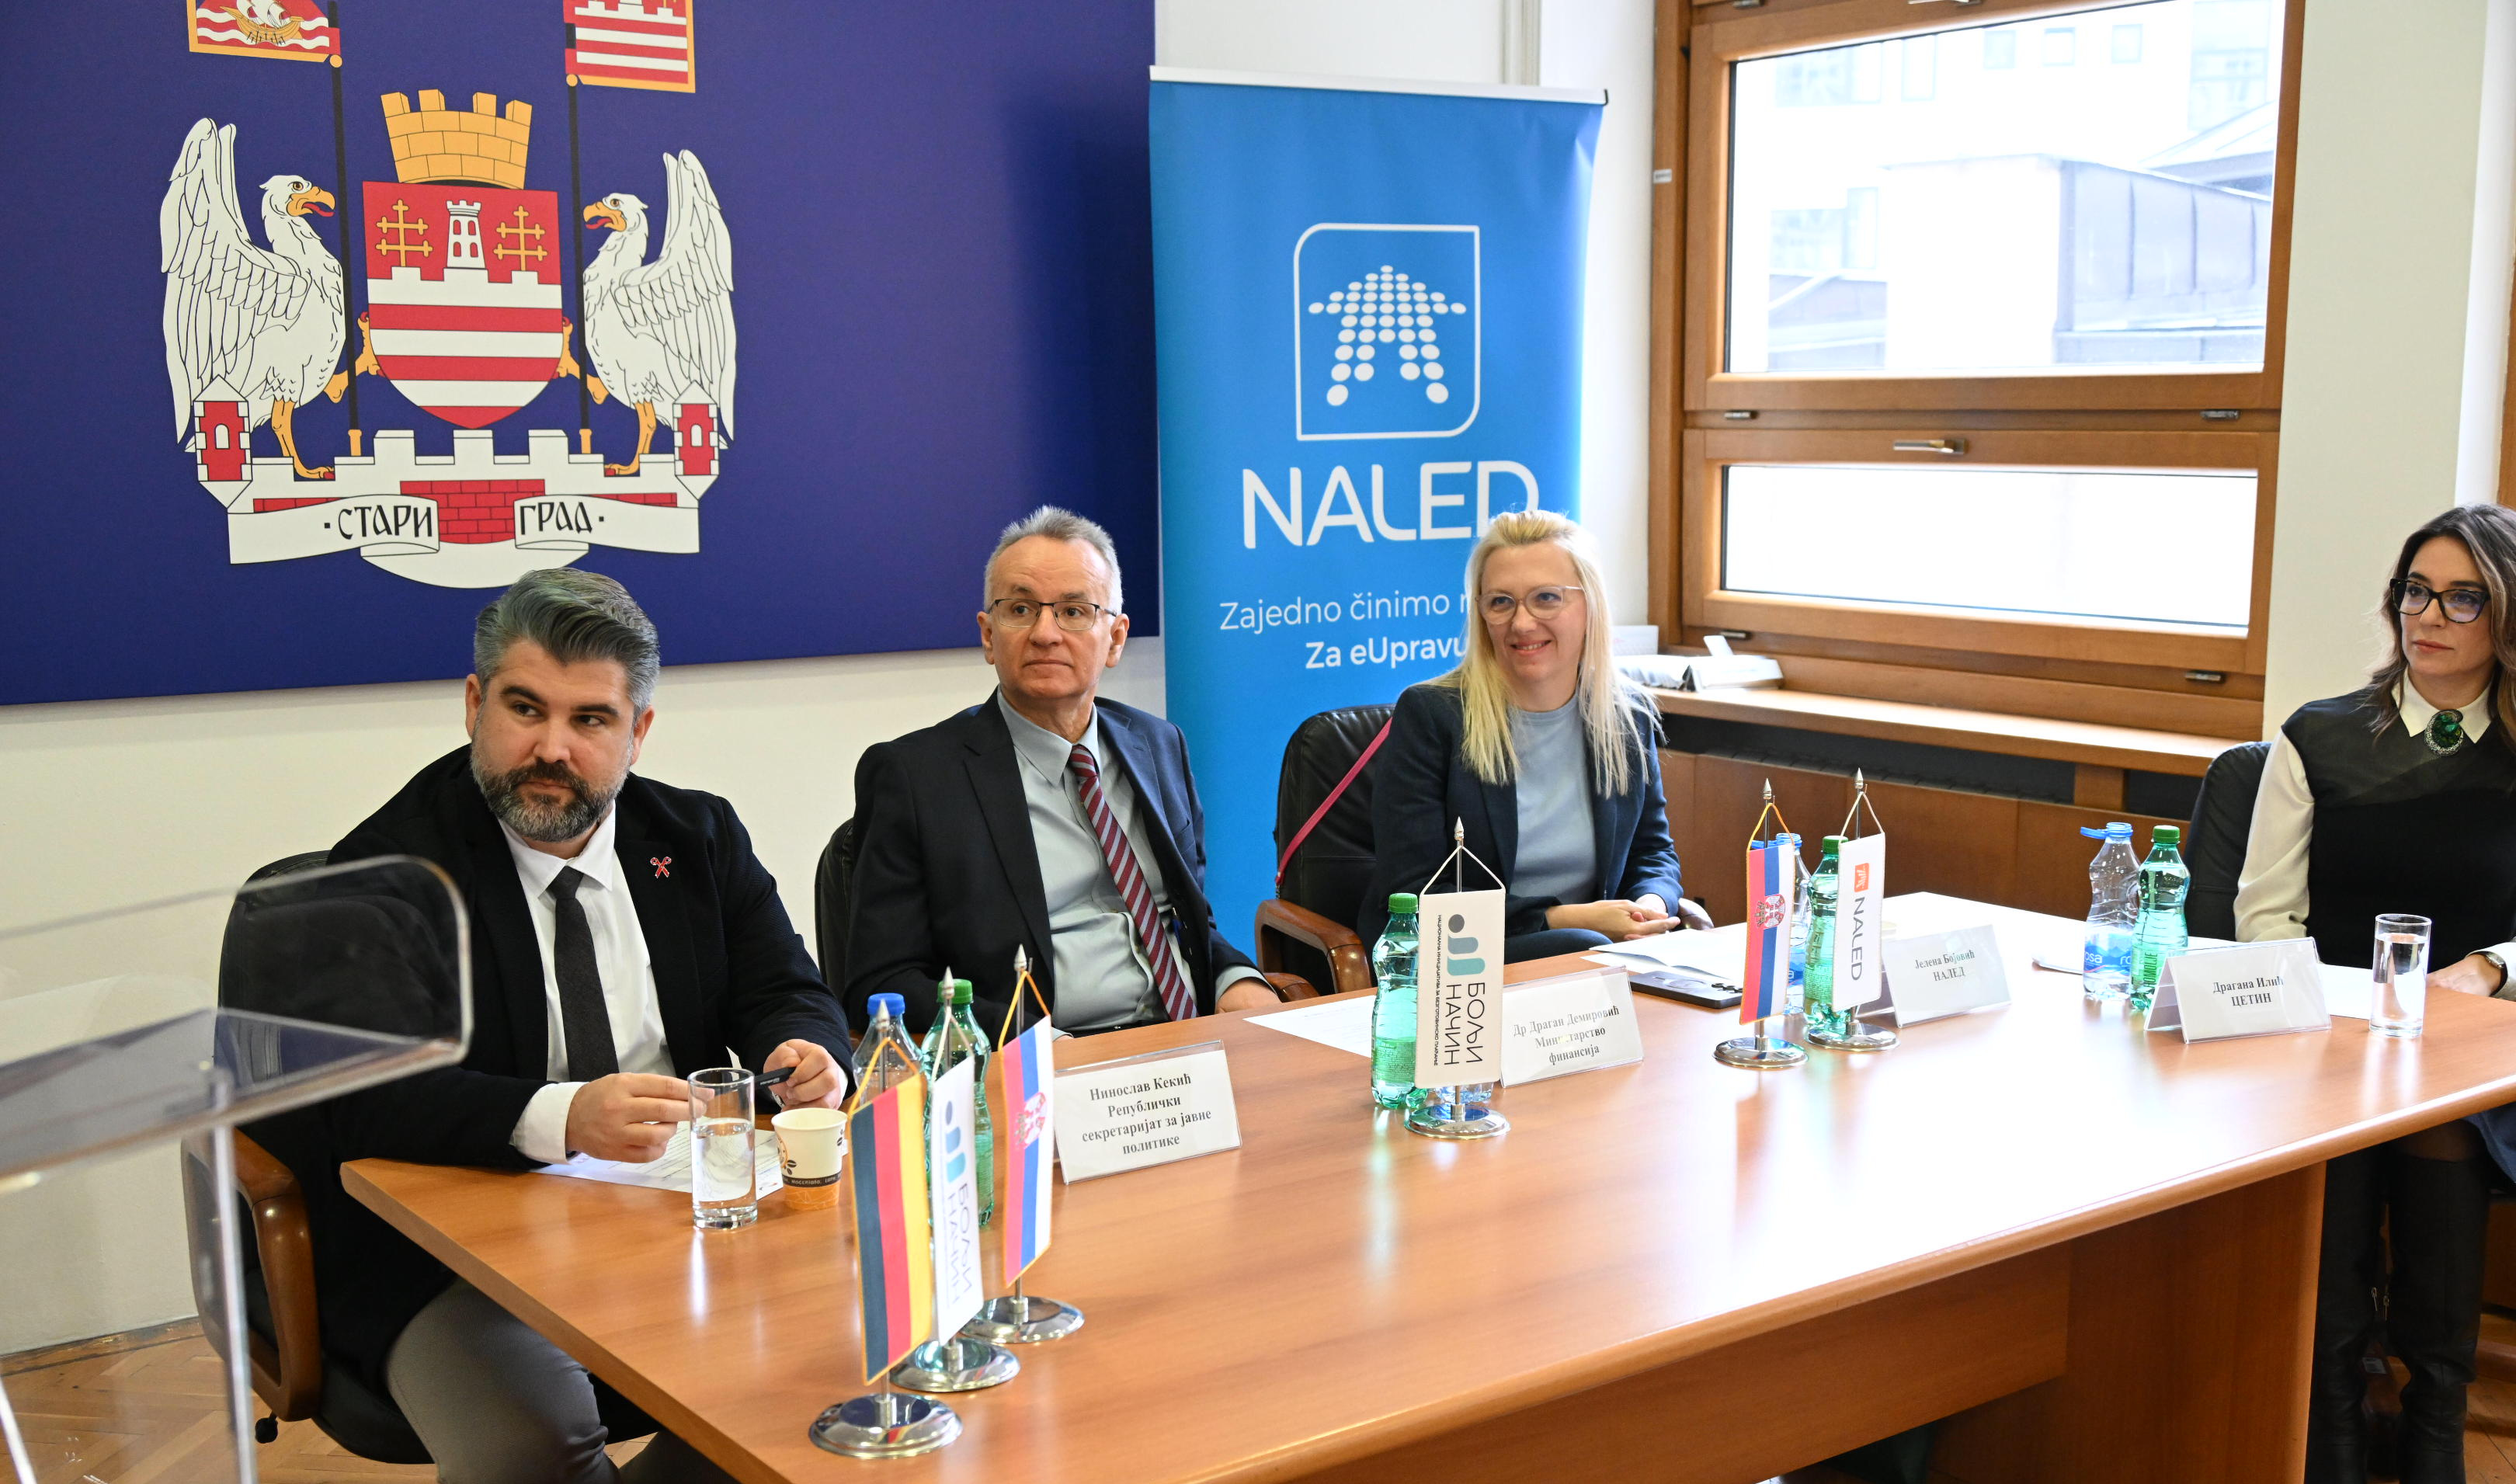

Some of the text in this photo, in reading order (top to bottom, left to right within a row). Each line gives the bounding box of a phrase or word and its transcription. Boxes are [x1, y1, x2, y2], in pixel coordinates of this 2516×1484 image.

[1242, 460, 1540, 549] NALED
[338, 502, 593, 540] СТАРИ ГРАД
[1219, 596, 1341, 634] Zajedno
[1350, 590, 1450, 620] činimo
[1305, 636, 1467, 669] Za eUpravu
[1851, 897, 1865, 981] NALED
[1915, 949, 1975, 969] Јелена Бојовић
[2085, 951, 2103, 964] osa
[1934, 967, 1965, 981] НАЛЕД
[2213, 975, 2284, 994] Драгана Илић
[2231, 992, 2271, 1007] ЦЕТИН
[1444, 984, 1461, 1065] НАЧИН
[1466, 982, 1485, 1062] БОЉИ
[1513, 1005, 1620, 1037] Др Драган Демировић
[1548, 1044, 1600, 1065] финансија
[1089, 1073, 1191, 1101] Нинослав Кекић
[1108, 1096, 1181, 1118] Републички
[1082, 1110, 1211, 1142] секретаријат за јавне
[1123, 1136, 1180, 1155] политике
